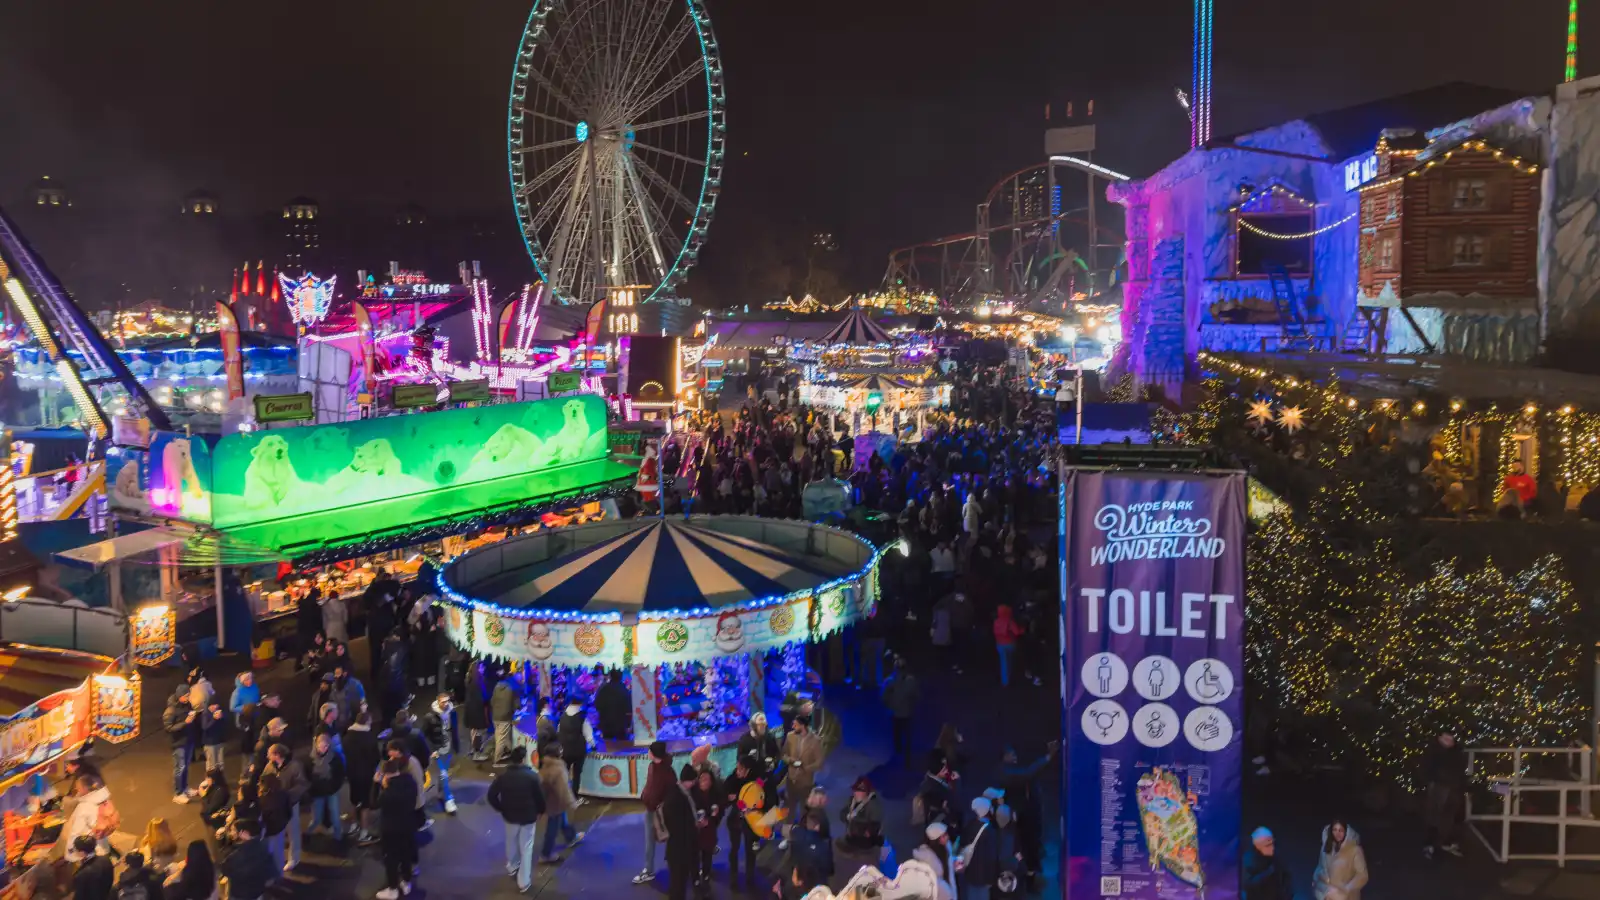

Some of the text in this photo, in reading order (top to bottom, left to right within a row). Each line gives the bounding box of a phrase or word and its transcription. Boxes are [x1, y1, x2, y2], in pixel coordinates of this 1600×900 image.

[1094, 504, 1211, 541] Winter
[1127, 500, 1194, 514] HYDE PARK
[1091, 538, 1226, 567] WONDERLAND
[1081, 588, 1235, 640] TOILET
